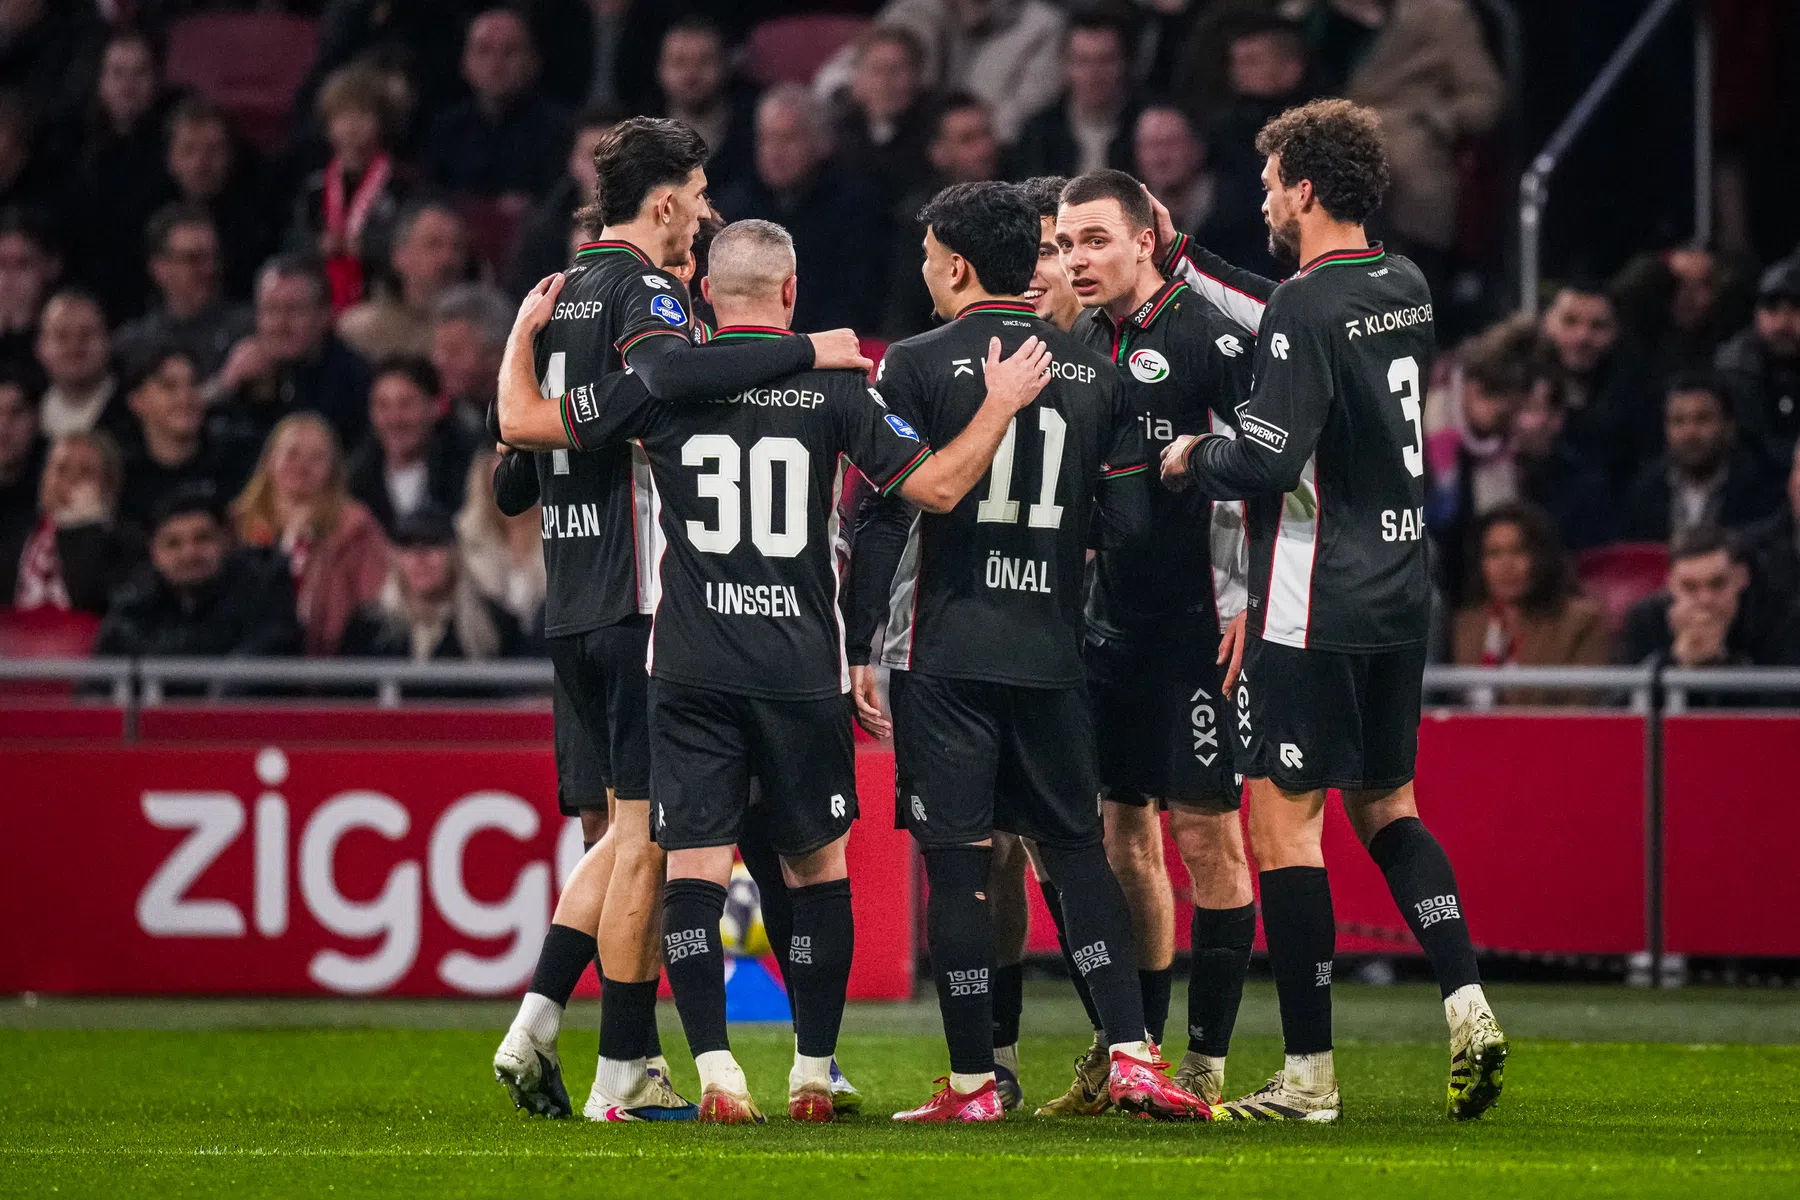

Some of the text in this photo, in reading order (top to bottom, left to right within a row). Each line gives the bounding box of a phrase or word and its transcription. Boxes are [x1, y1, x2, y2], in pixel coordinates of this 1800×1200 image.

[551, 301, 603, 321] GROEP
[1134, 302, 1154, 323] 2025
[1138, 411, 1173, 440] ia
[1387, 356, 1424, 478] 3
[977, 407, 1067, 529] 11
[681, 434, 810, 558] 30
[541, 503, 601, 540] APLAN
[986, 550, 1051, 593] ÖNAL
[706, 582, 801, 617] LINSSEN
[1414, 895, 1457, 914] 1900
[1420, 908, 1461, 929] 2025
[664, 928, 707, 946] 1900
[668, 941, 710, 965] 2025
[1073, 940, 1107, 964] 1900
[946, 968, 989, 983] 1900
[1078, 954, 1112, 977] 2025
[950, 981, 989, 997] 2025
